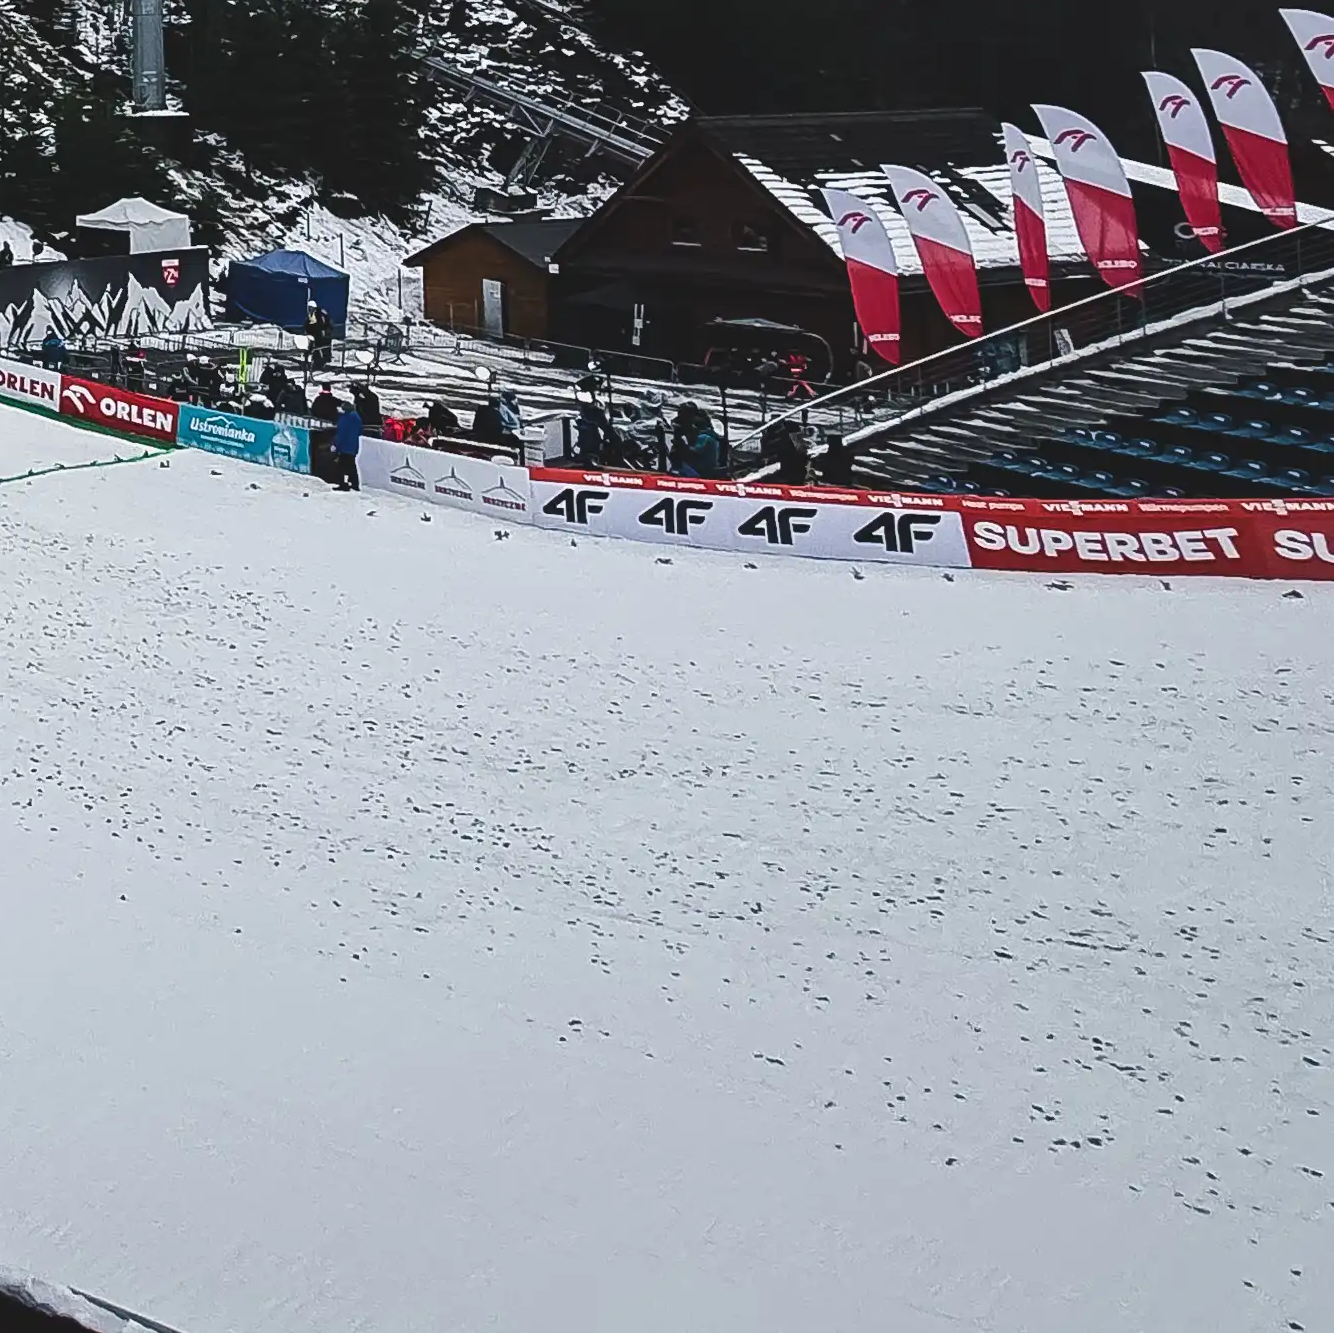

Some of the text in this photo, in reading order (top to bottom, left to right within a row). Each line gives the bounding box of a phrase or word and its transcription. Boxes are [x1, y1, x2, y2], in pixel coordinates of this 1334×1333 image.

[99, 397, 173, 433] ORLEN
[542, 488, 610, 525] 4F
[638, 497, 714, 536] 4F
[737, 505, 818, 546] 4F
[852, 511, 942, 554] 4F
[972, 521, 1241, 562] SUPERBET
